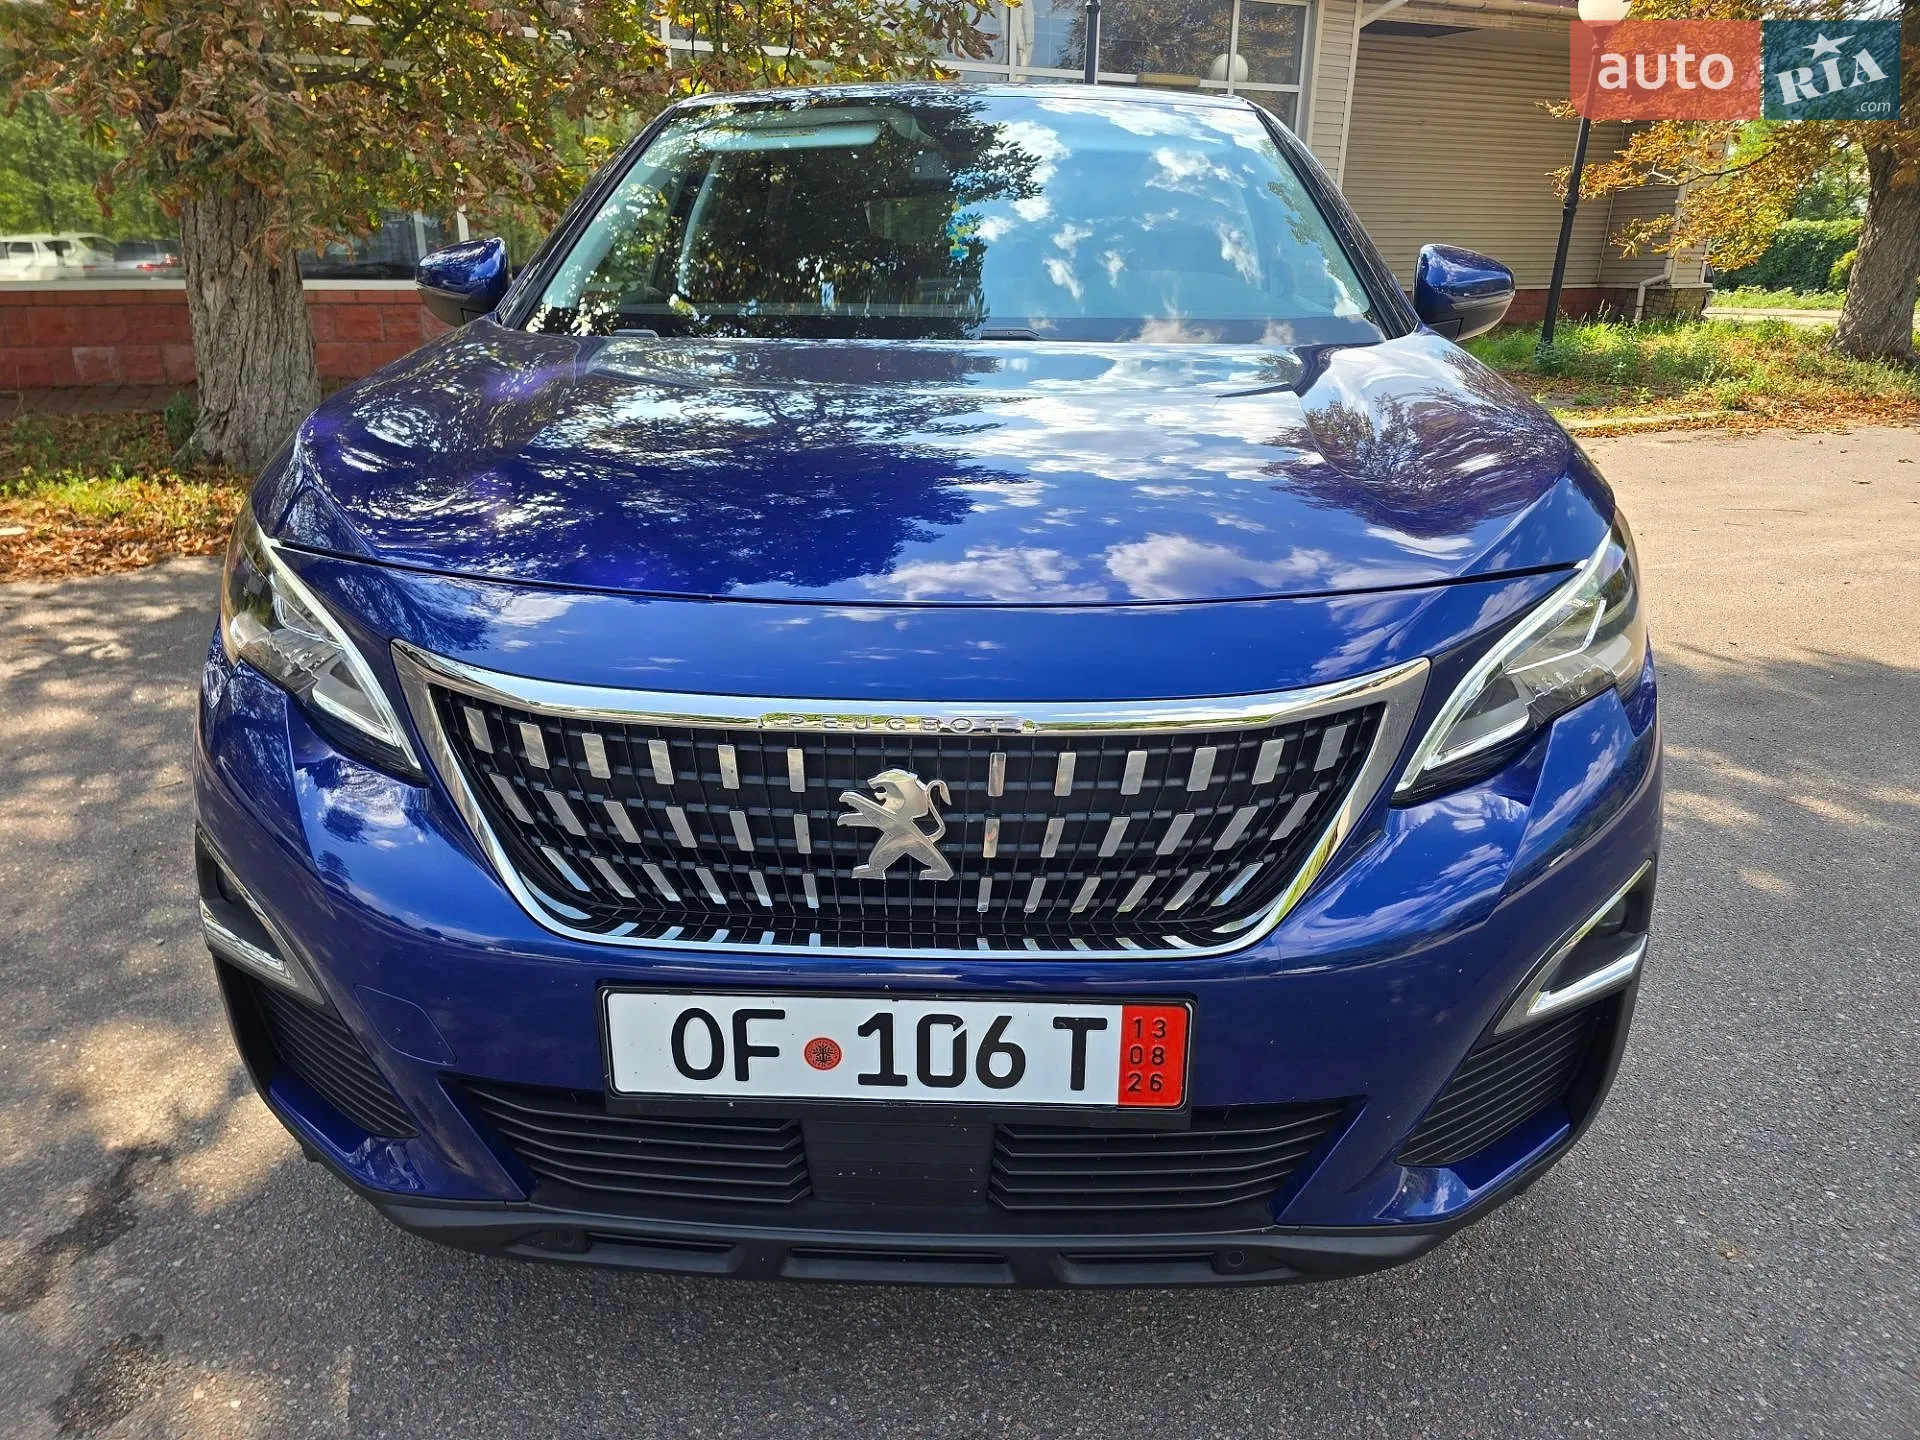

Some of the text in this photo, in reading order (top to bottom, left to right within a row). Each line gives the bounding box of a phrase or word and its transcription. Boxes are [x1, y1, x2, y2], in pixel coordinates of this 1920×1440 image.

[788, 713, 1004, 733] PEUGEOT
[1133, 1017, 1166, 1039] 13
[670, 1007, 1108, 1091] OF 106 T
[1129, 1045, 1165, 1066] 08
[1127, 1072, 1164, 1092] 26
